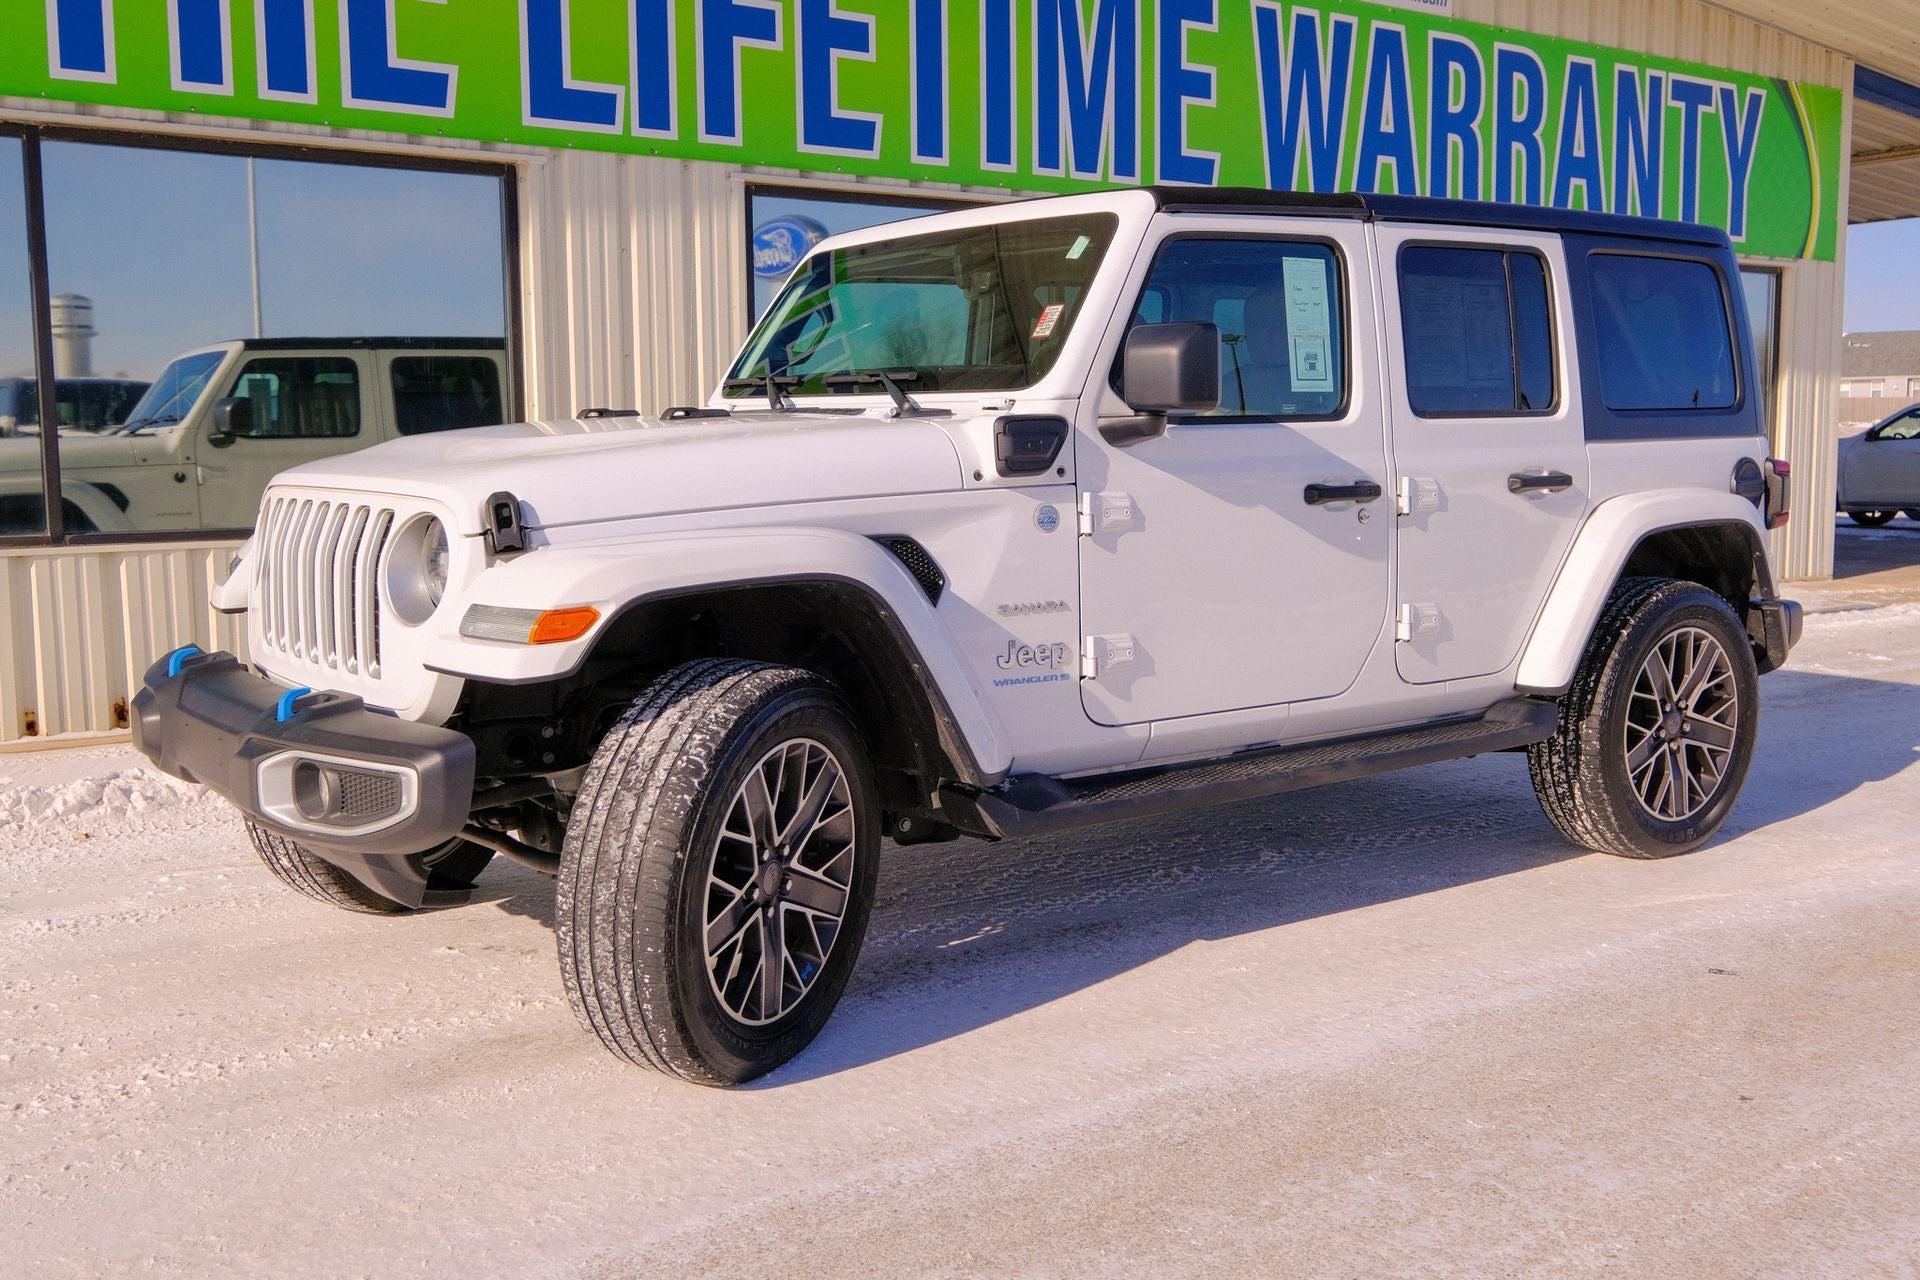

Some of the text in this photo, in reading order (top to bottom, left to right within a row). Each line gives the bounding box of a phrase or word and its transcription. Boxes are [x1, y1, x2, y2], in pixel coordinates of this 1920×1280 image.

[519, 0, 1221, 188] LIFETIME
[1253, 1, 1768, 243] WARRANTY
[996, 639, 1072, 670] Jeep
[993, 674, 1059, 687] WRANGLER
